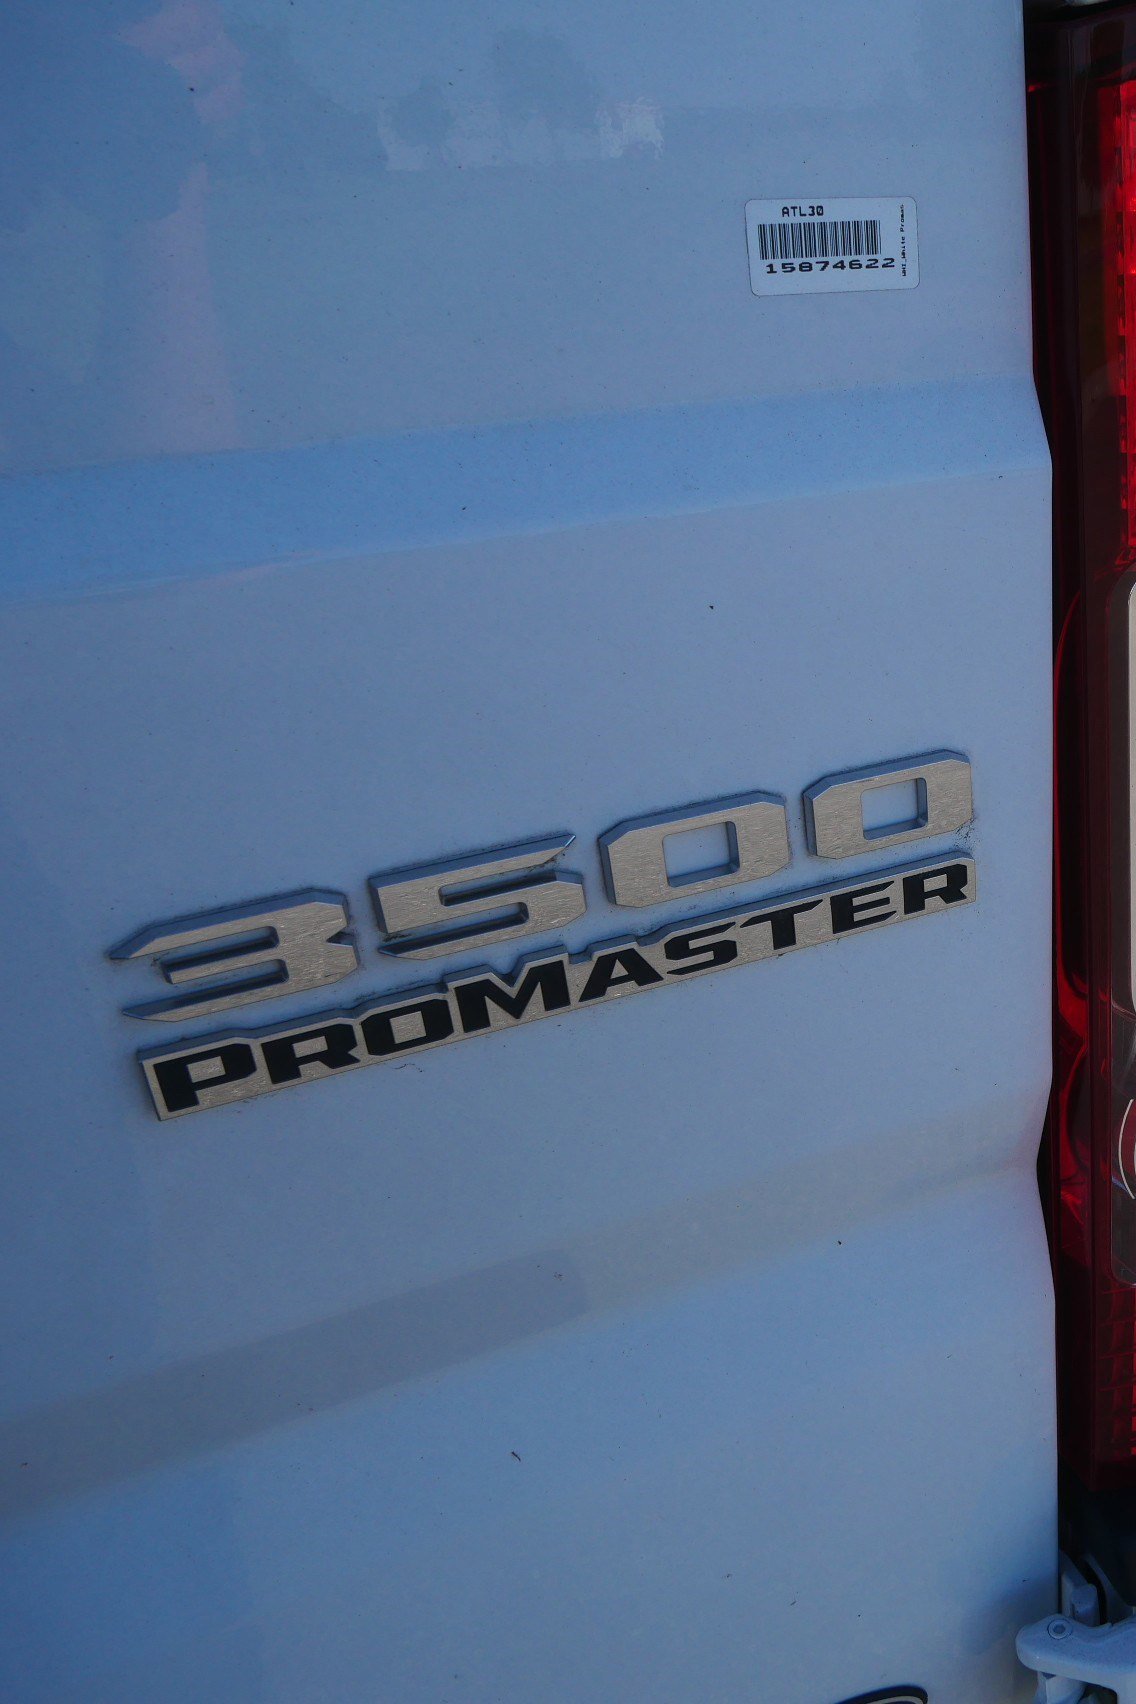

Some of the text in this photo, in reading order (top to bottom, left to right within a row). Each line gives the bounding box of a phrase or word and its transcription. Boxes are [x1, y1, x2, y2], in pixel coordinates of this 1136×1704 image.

[766, 257, 895, 274] 15874622
[781, 205, 824, 217] ATL30
[110, 748, 976, 1022] 3500
[153, 861, 971, 1113] PROMASTER
